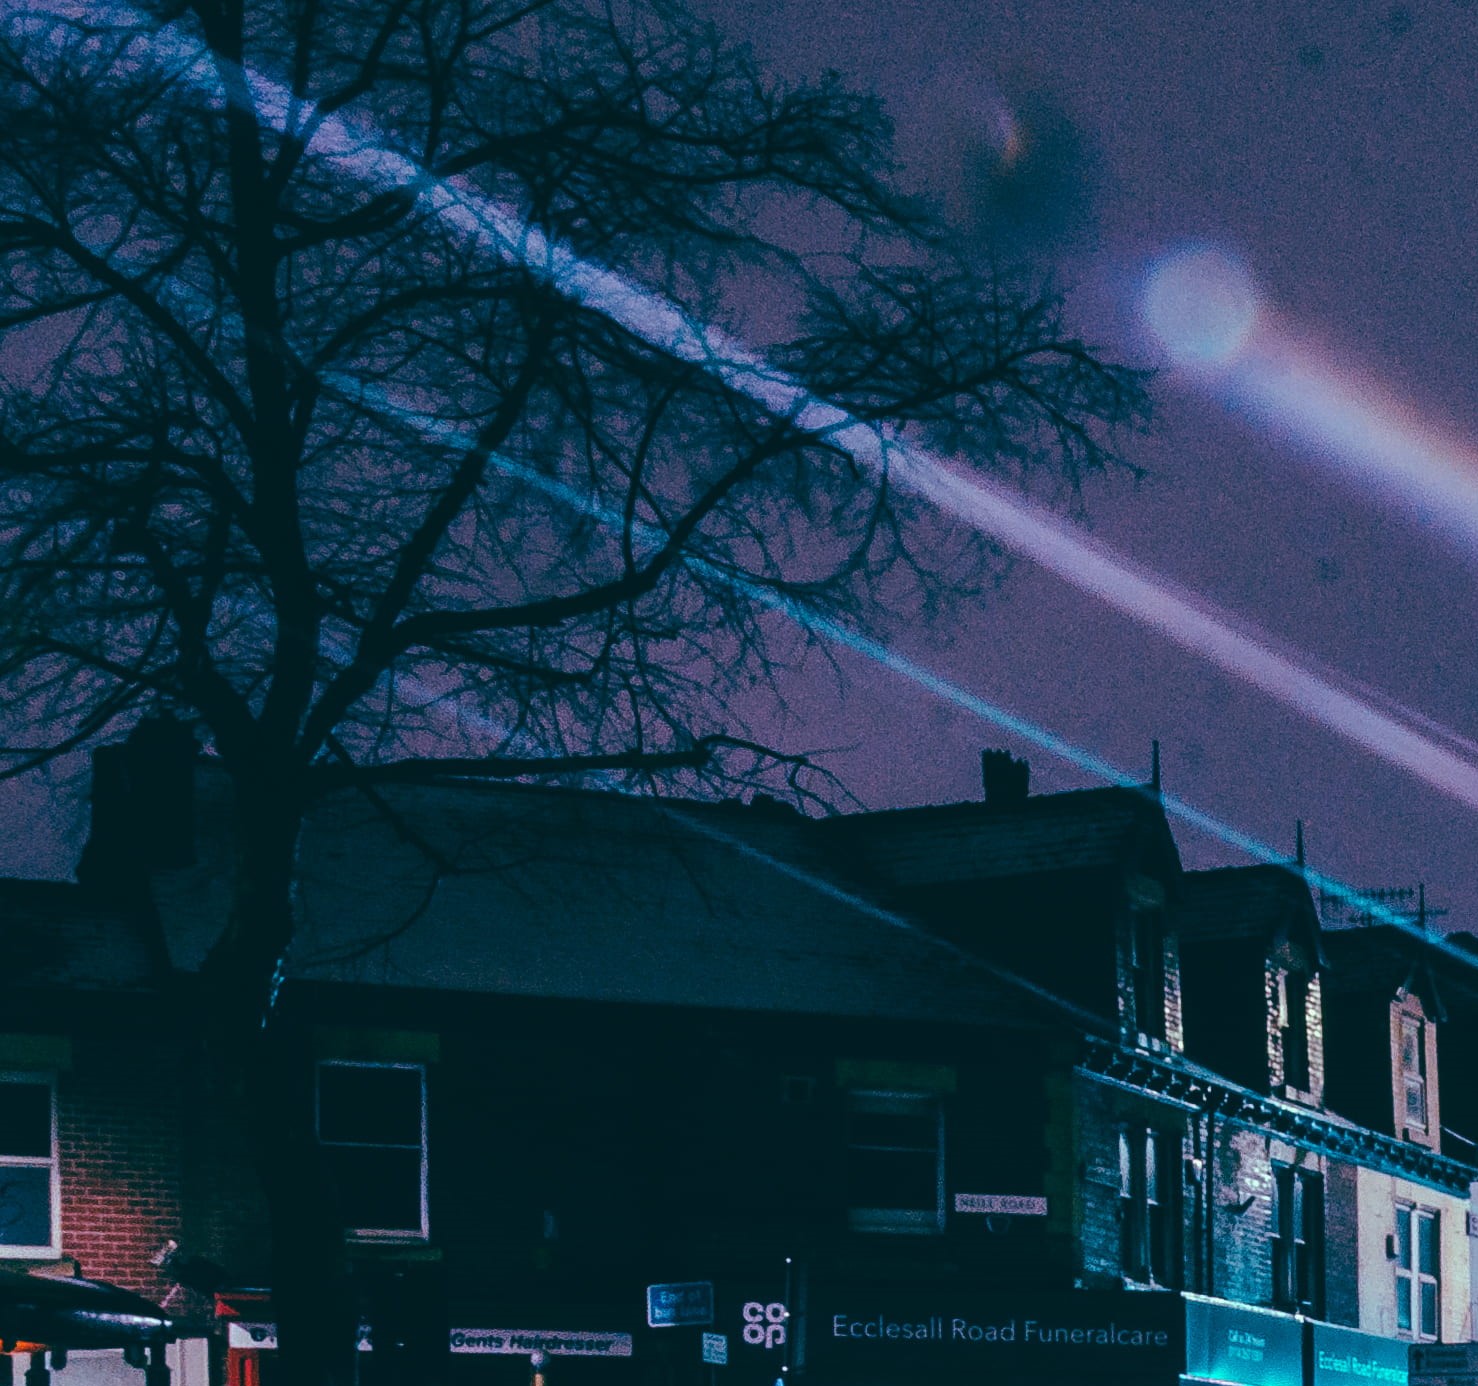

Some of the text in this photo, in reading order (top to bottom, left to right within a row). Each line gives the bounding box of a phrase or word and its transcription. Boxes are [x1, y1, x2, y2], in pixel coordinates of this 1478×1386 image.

[451, 1331, 613, 1351] Gents Hairdresser
[832, 1314, 1168, 1347] Ecclesall Road Funeralcare
